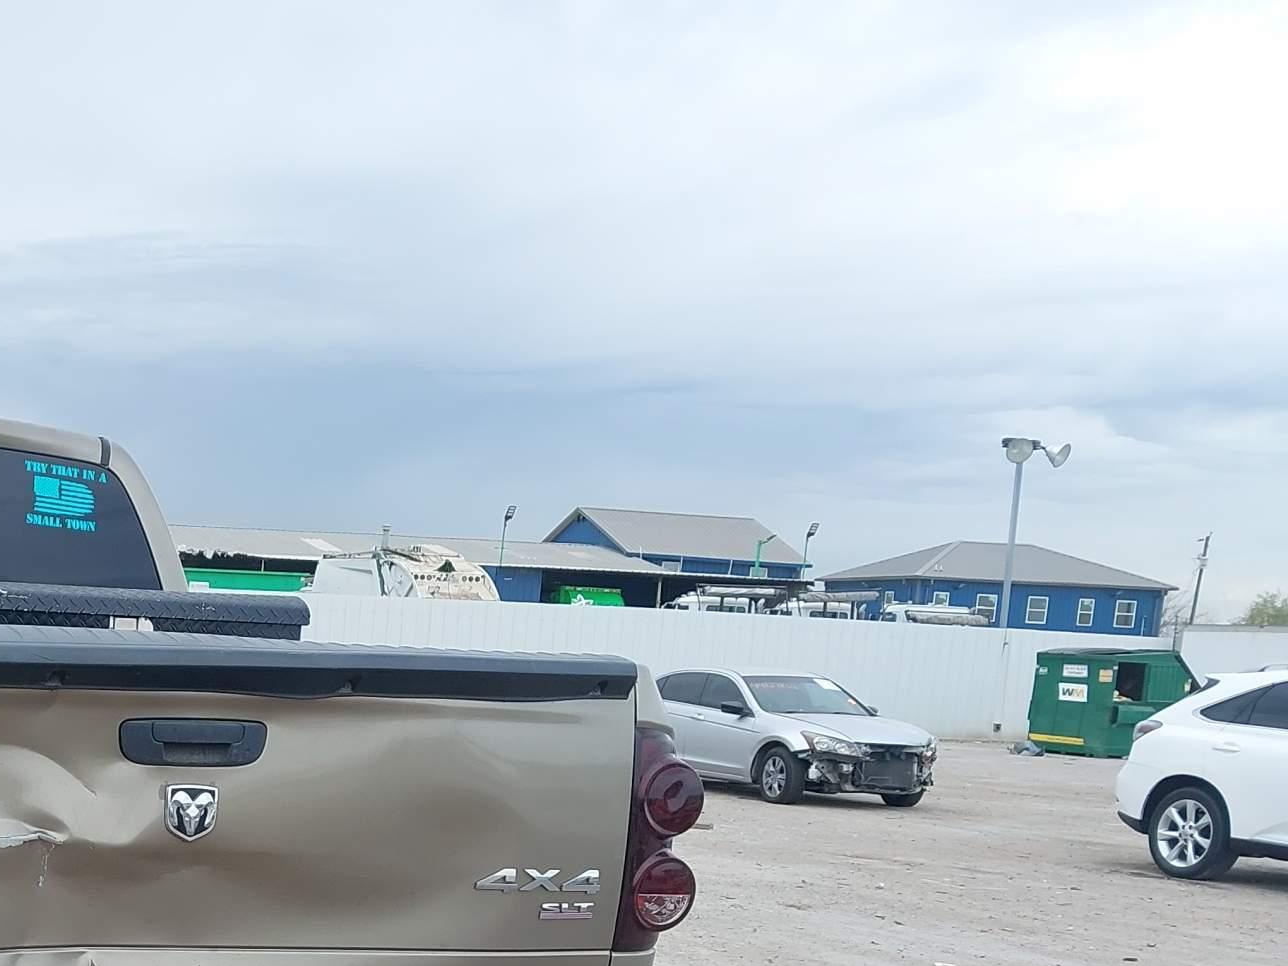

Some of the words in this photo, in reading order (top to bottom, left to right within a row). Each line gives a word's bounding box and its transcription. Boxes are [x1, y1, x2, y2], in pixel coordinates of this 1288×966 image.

[24, 459, 48, 474] TRY
[51, 463, 79, 478] THAT
[82, 469, 96, 481] IN
[98, 472, 107, 483] A
[26, 513, 62, 528] SMALL
[65, 518, 96, 532] TOWN
[1061, 687, 1085, 697] WM
[474, 868, 601, 895] 4X4
[540, 902, 595, 914] SLT
